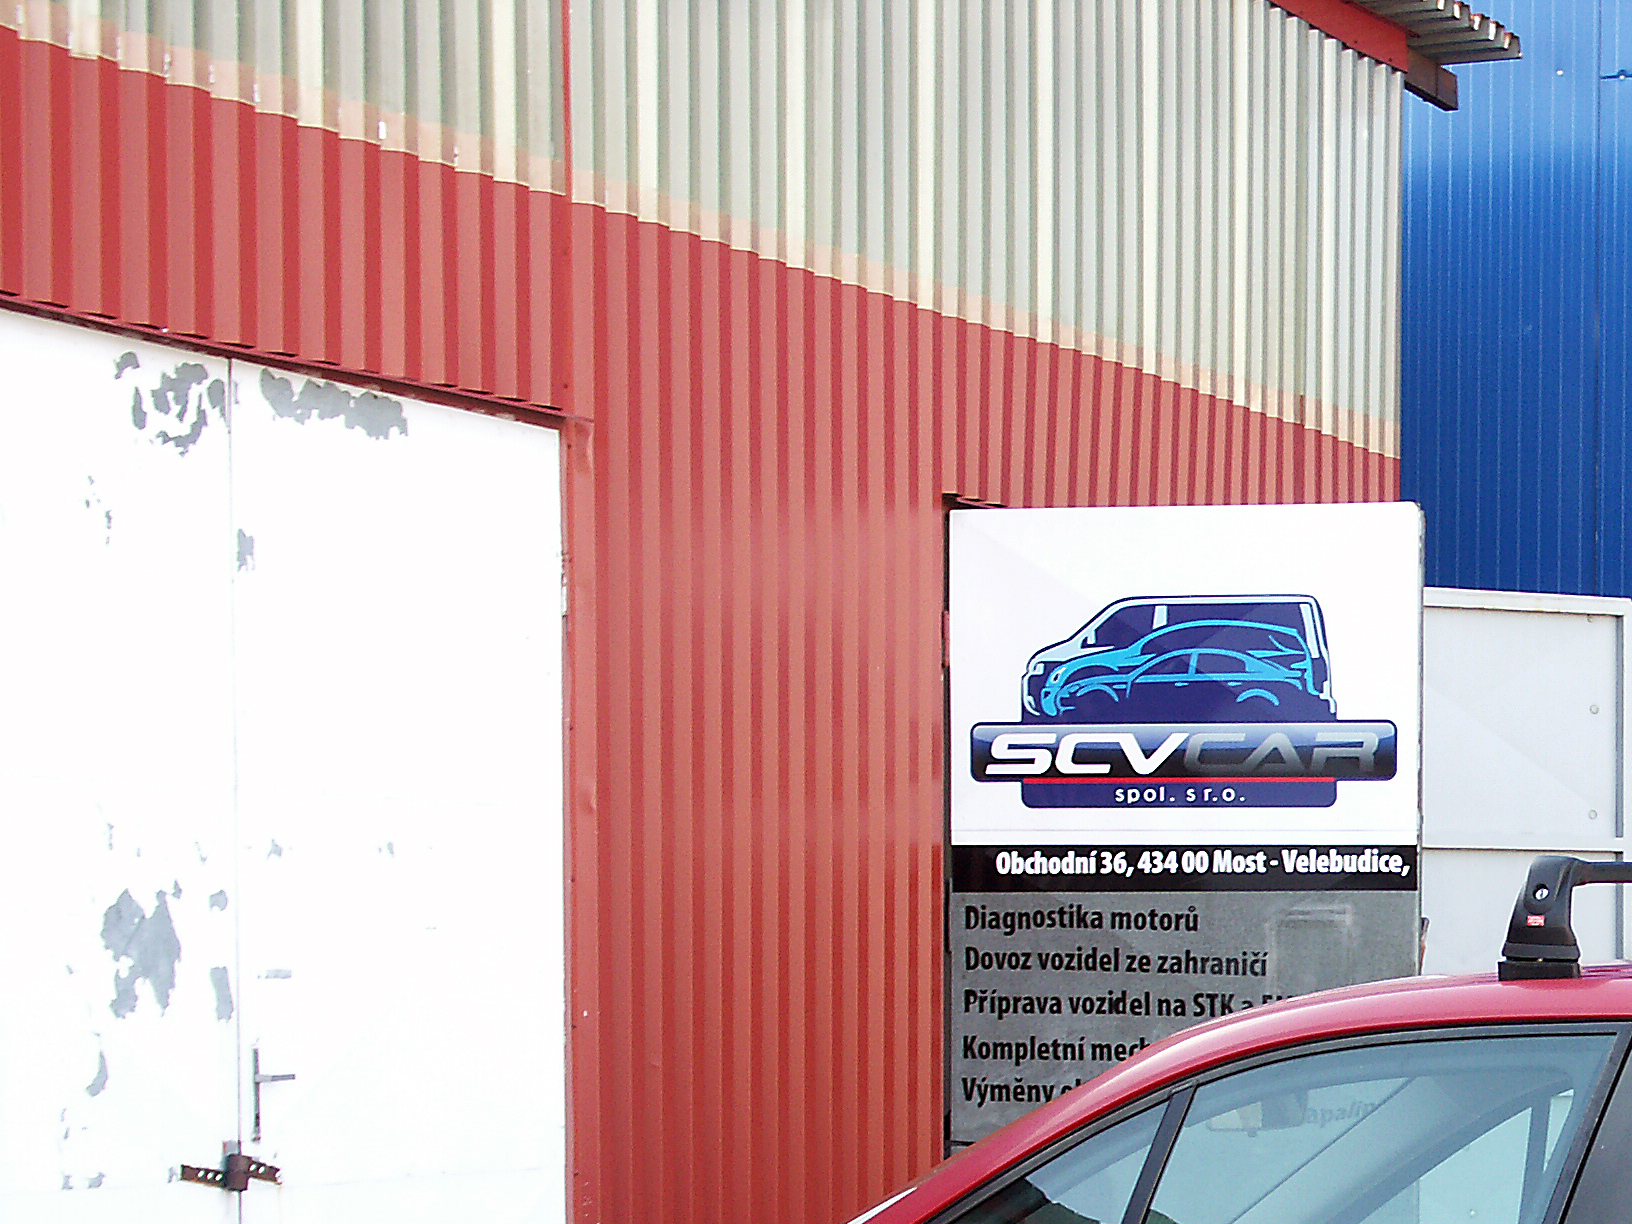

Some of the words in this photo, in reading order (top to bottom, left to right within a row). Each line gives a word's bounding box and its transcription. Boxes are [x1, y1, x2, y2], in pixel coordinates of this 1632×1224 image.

[1115, 787, 1175, 804] spol.
[1186, 788, 1196, 803] s
[1203, 788, 1246, 803] r.o.
[996, 850, 1097, 875] Obchodní
[1100, 850, 1135, 878] 36,
[1137, 850, 1178, 875] 434
[1181, 850, 1209, 874] 00
[1212, 848, 1267, 874] Most
[1281, 848, 1411, 877] Velebudice,
[965, 904, 1103, 936] Diagnostika
[1110, 905, 1199, 931] motorů
[965, 946, 1032, 971] Dovoz
[1037, 946, 1120, 972] vozidel
[1125, 954, 1151, 973] ze
[1156, 949, 1268, 977] zahraničí
[964, 989, 1062, 1020] Příprava
[1068, 989, 1150, 1016] vozidel
[1157, 997, 1186, 1016] na
[1193, 992, 1235, 1018] STK
[962, 1035, 1086, 1066] Kompletní
[961, 1077, 1055, 1108] Výměny
